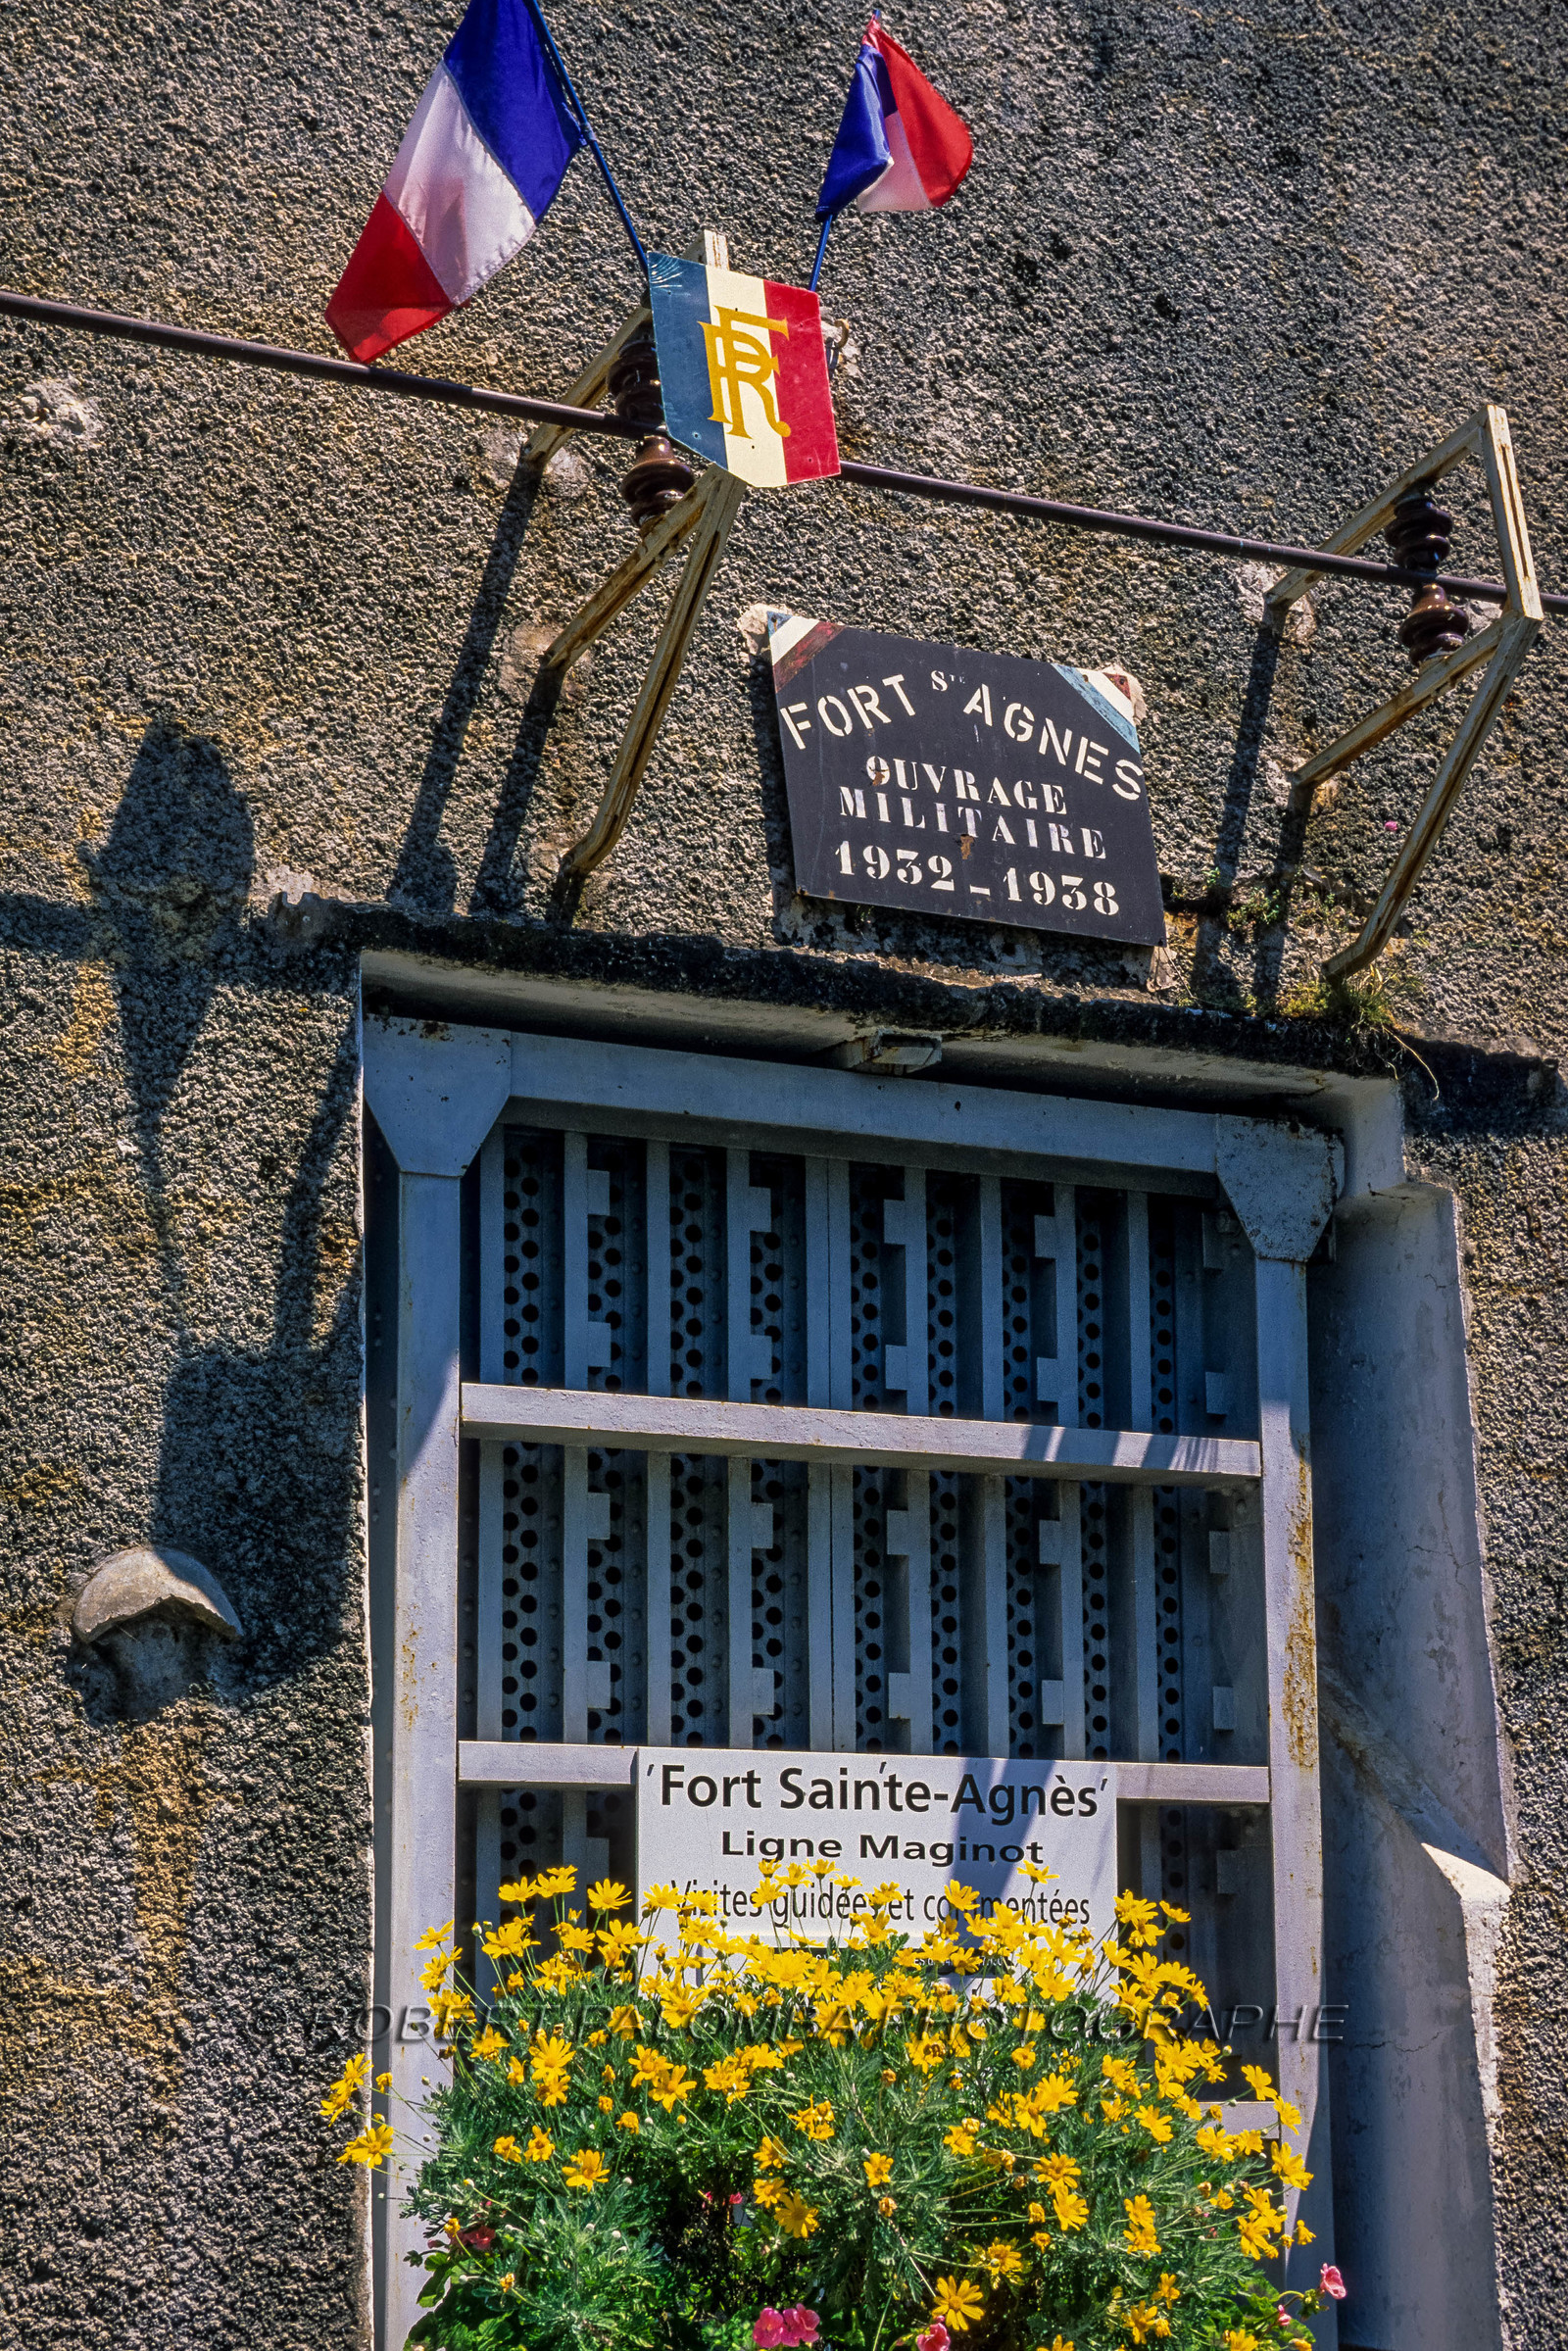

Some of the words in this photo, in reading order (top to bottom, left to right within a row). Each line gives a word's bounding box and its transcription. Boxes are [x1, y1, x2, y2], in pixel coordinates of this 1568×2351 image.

[780, 673, 915, 750] FORT
[962, 683, 1144, 801] AGNES
[865, 756, 1067, 815] OUVRAGE
[839, 786, 1106, 859] MILITAIRE
[722, 1831, 842, 1863] Ligne
[859, 1835, 1044, 1868] Maginot
[888, 1888, 914, 1921] et
